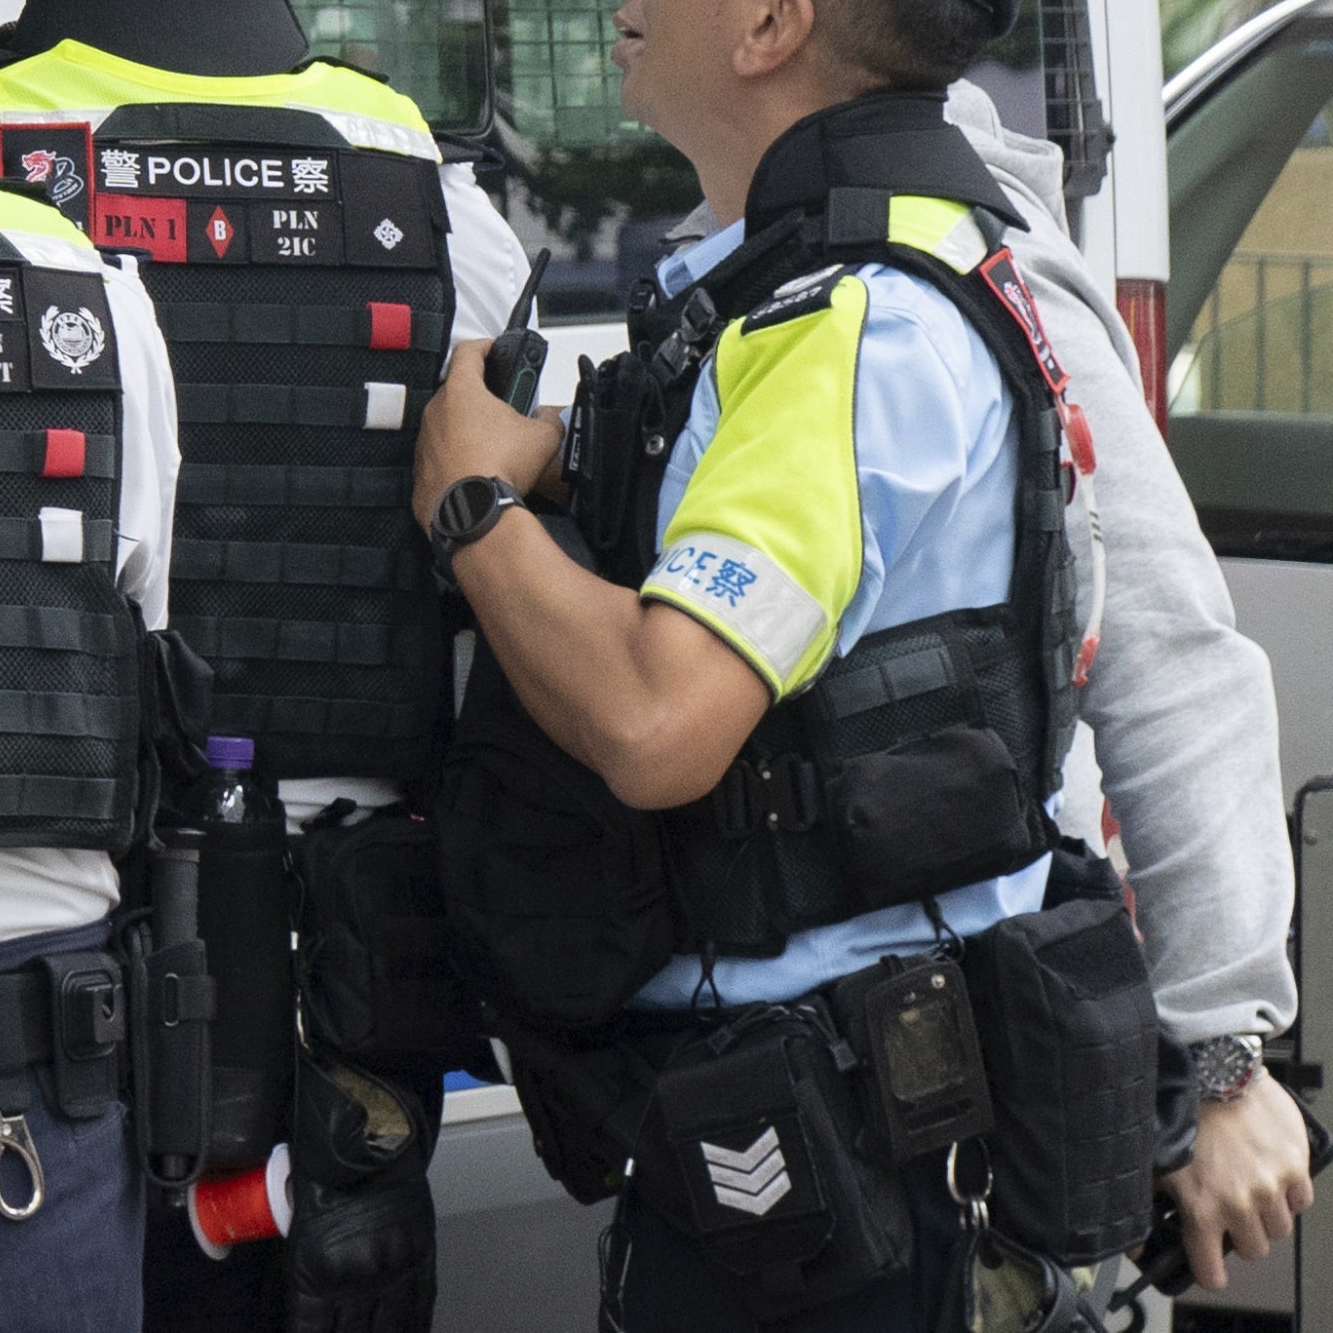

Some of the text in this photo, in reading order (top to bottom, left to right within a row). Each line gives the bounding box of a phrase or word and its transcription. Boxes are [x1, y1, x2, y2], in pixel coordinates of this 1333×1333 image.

[101, 149, 329, 194] 警 POLICE 察
[104, 214, 177, 241] PLN 1
[213, 219, 226, 241] B
[271, 210, 319, 230] PLN
[277, 237, 316, 257] 2IC
[705, 558, 758, 608] 察
